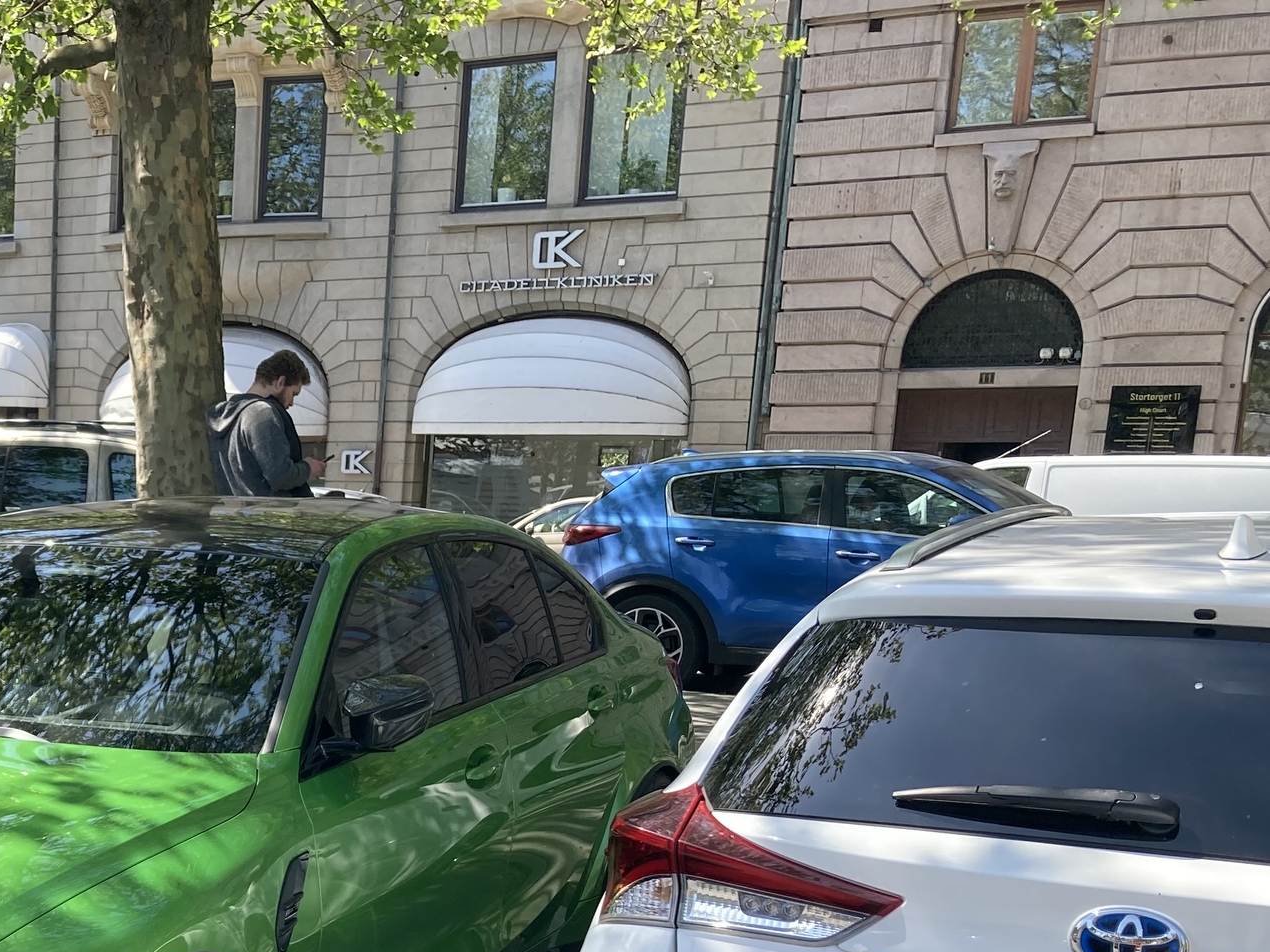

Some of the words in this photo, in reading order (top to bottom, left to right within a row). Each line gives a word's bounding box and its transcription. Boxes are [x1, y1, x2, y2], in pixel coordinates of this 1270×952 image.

[459, 273, 656, 293] CITADELLKLINIKEN
[1130, 392, 1172, 402] Stortorget
[1174, 392, 1181, 401] 11
